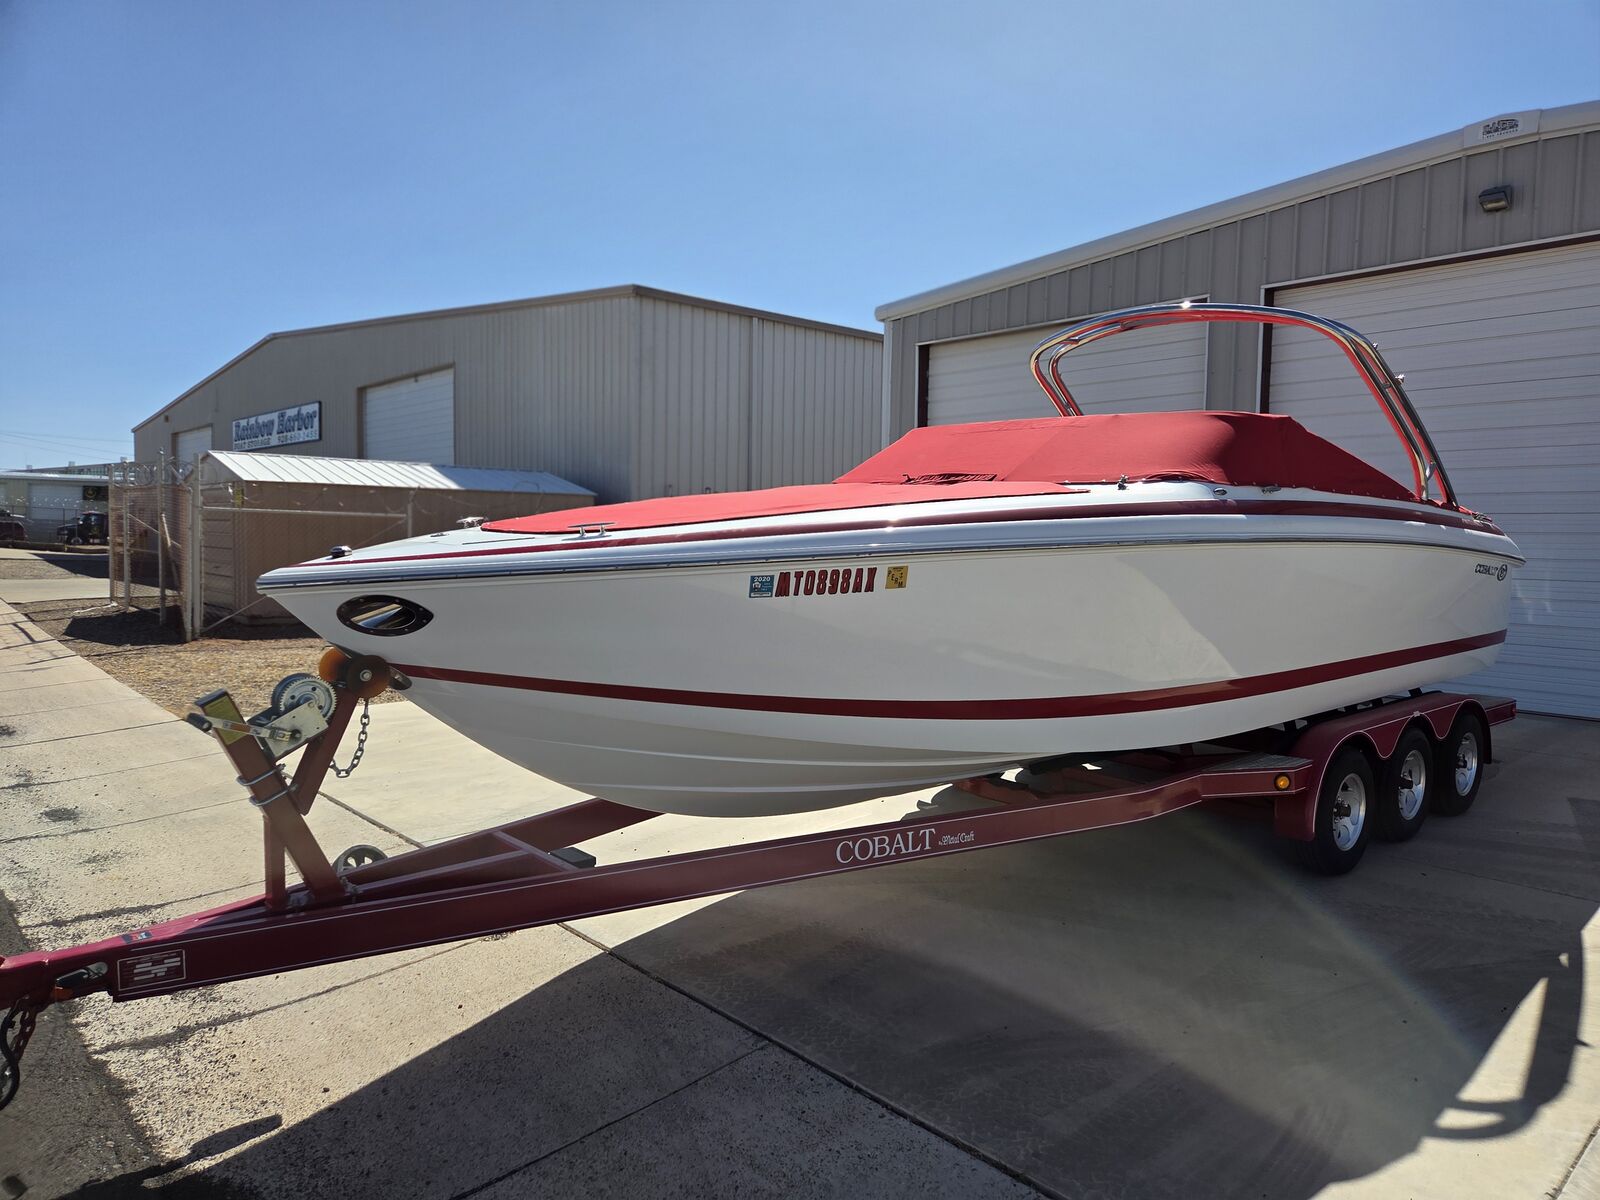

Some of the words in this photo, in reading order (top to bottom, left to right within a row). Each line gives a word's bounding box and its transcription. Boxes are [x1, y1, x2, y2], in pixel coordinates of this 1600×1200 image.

[277, 408, 317, 434] Harbor
[774, 567, 877, 597] MT0898AX
[836, 828, 936, 864] COBALT
